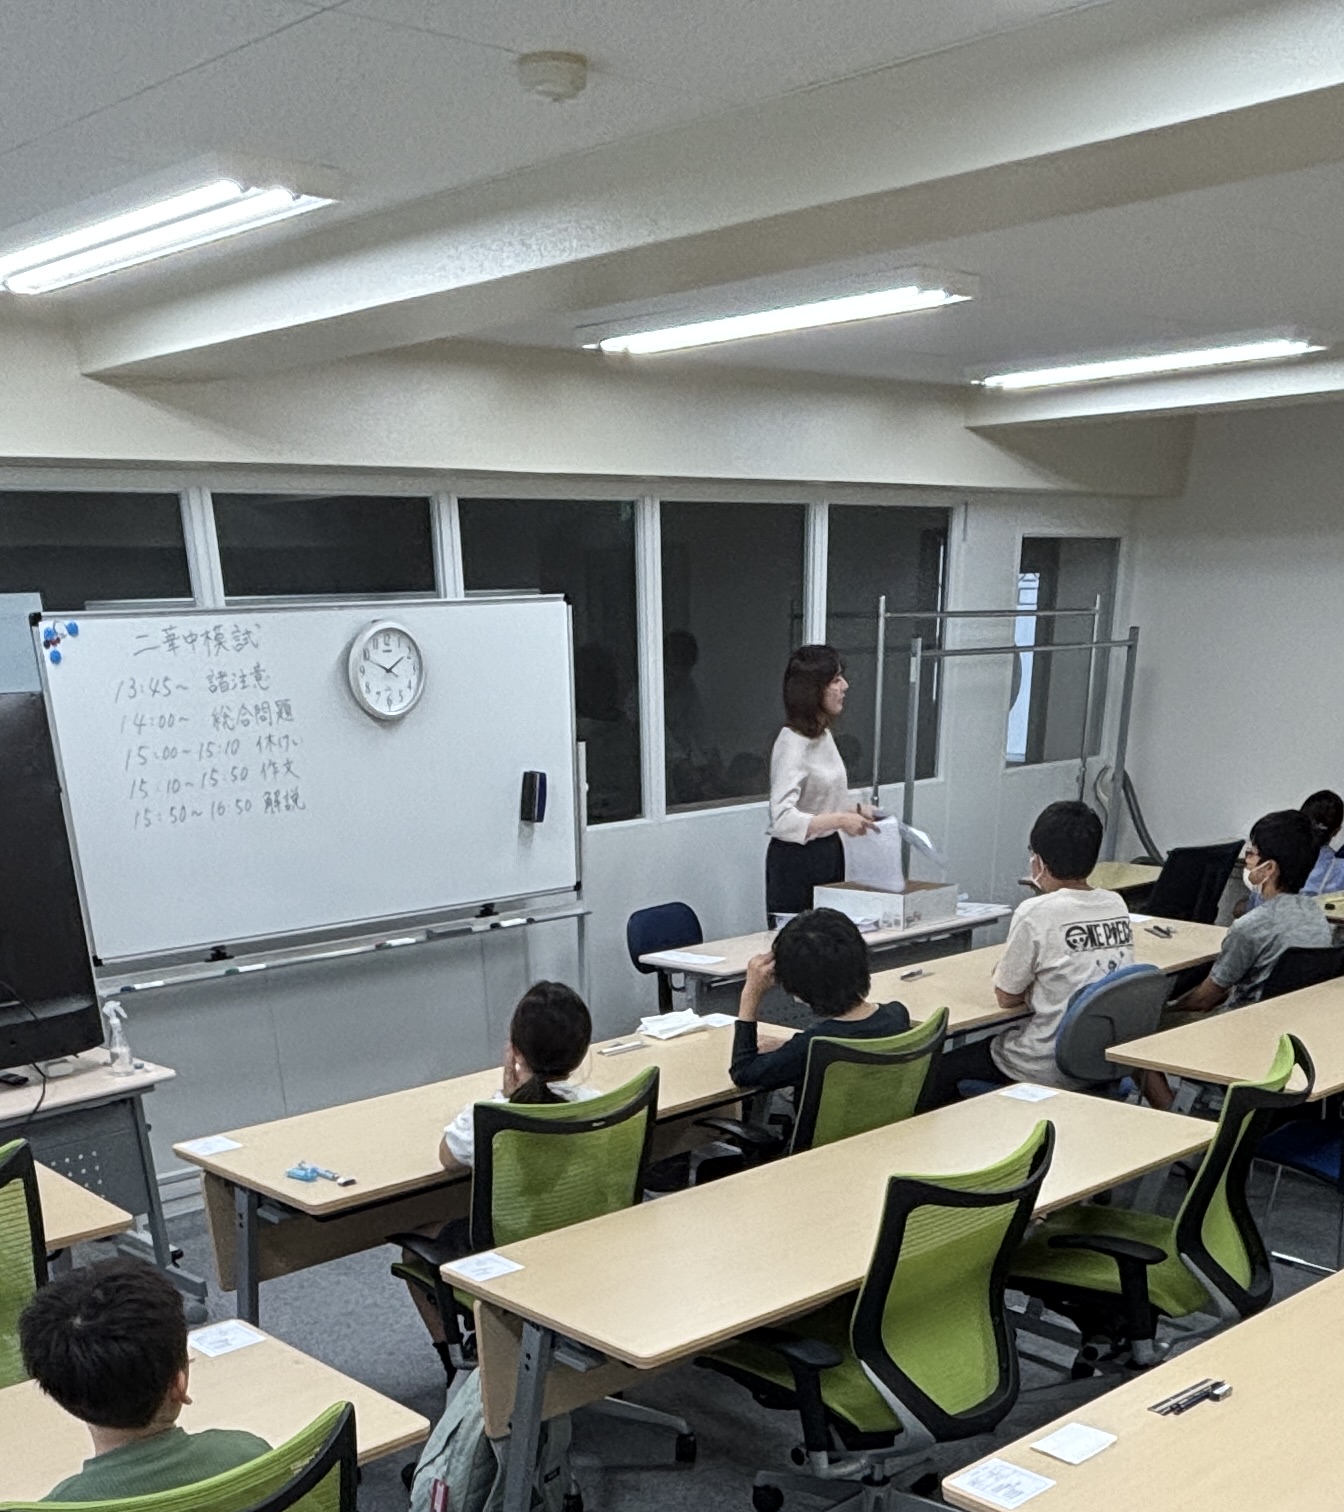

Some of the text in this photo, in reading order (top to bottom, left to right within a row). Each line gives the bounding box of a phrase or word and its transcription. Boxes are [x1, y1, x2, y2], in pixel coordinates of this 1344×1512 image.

[133, 623, 261, 657] 二華中模試
[384, 634, 390, 646] 12
[205, 662, 271, 694] 諸注意
[211, 698, 296, 731] 総合問題
[260, 758, 300, 781] 作文
[263, 786, 307, 815] 解説
[1065, 925, 1105, 951] ONE
